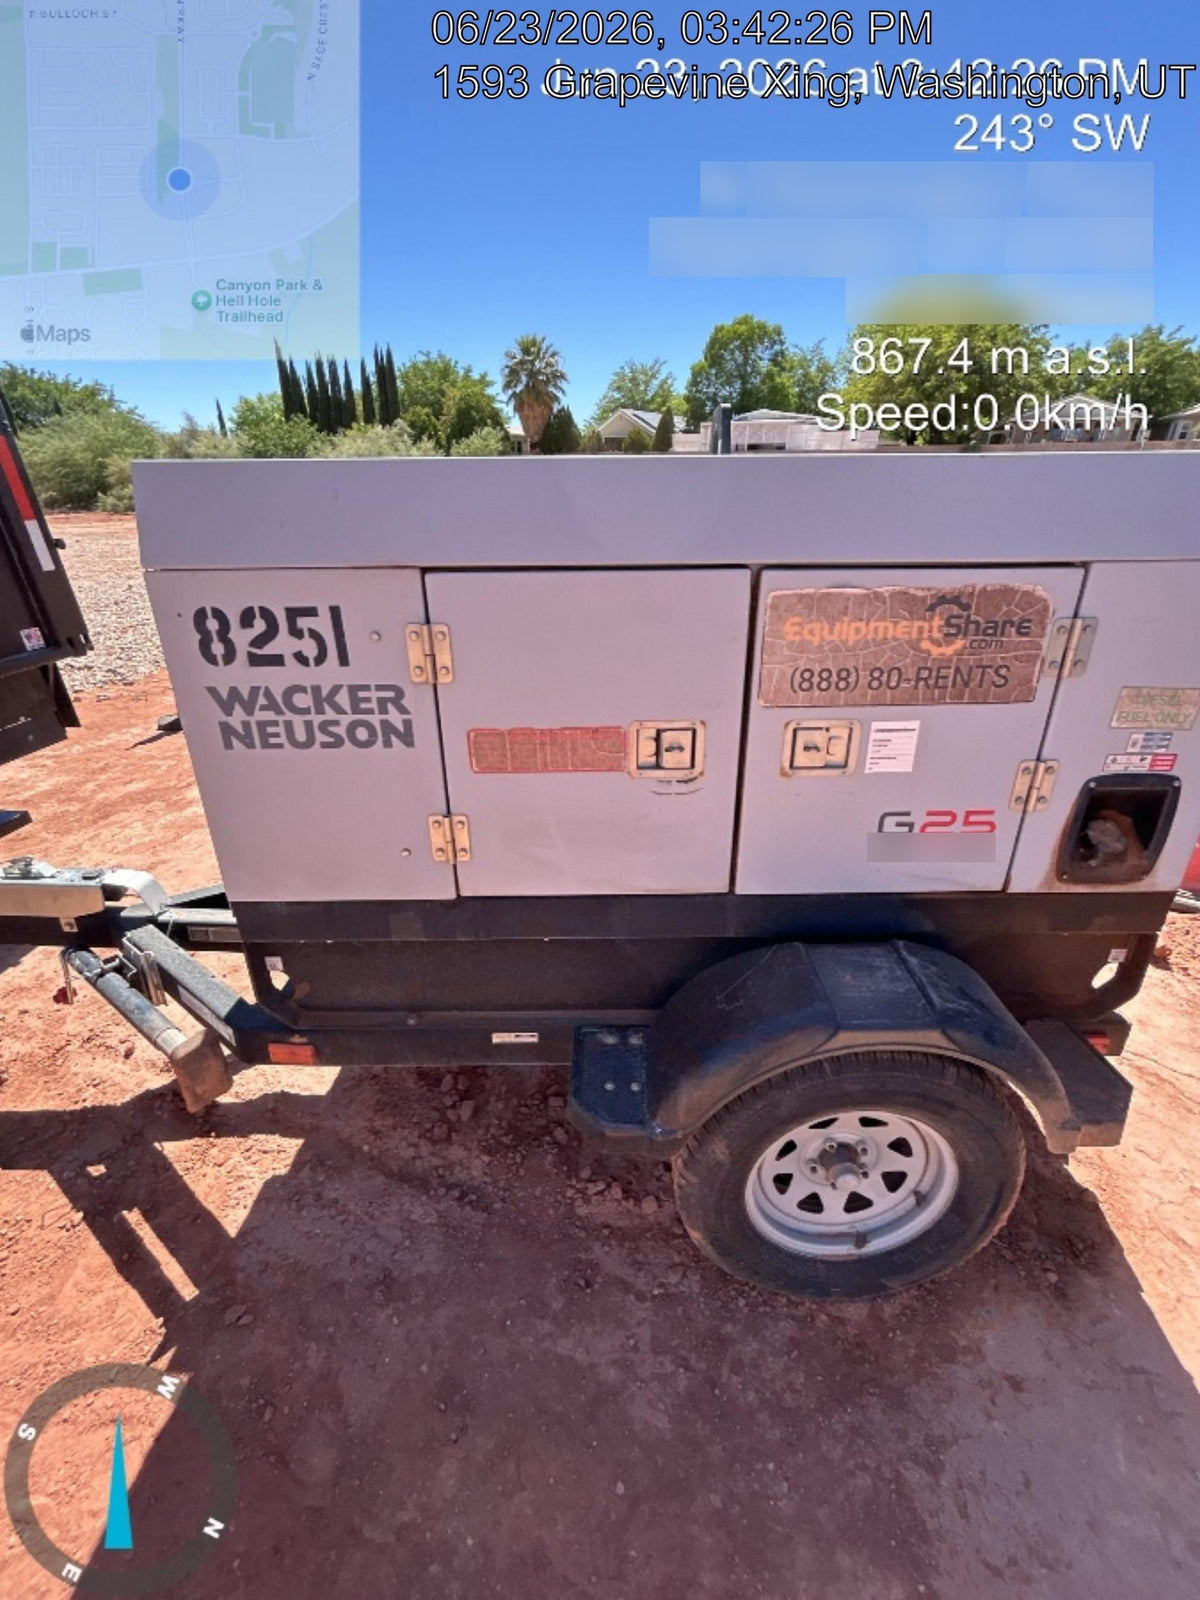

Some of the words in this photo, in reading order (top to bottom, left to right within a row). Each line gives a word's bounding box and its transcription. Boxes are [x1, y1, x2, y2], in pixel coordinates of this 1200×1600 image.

[790, 666, 860, 694] (888)
[867, 664, 1011, 692] 80-RENTS
[204, 683, 413, 717] WACKER
[1116, 711, 1149, 722] FUEL
[218, 718, 415, 751] NEUSON
[877, 809, 997, 834] G25
